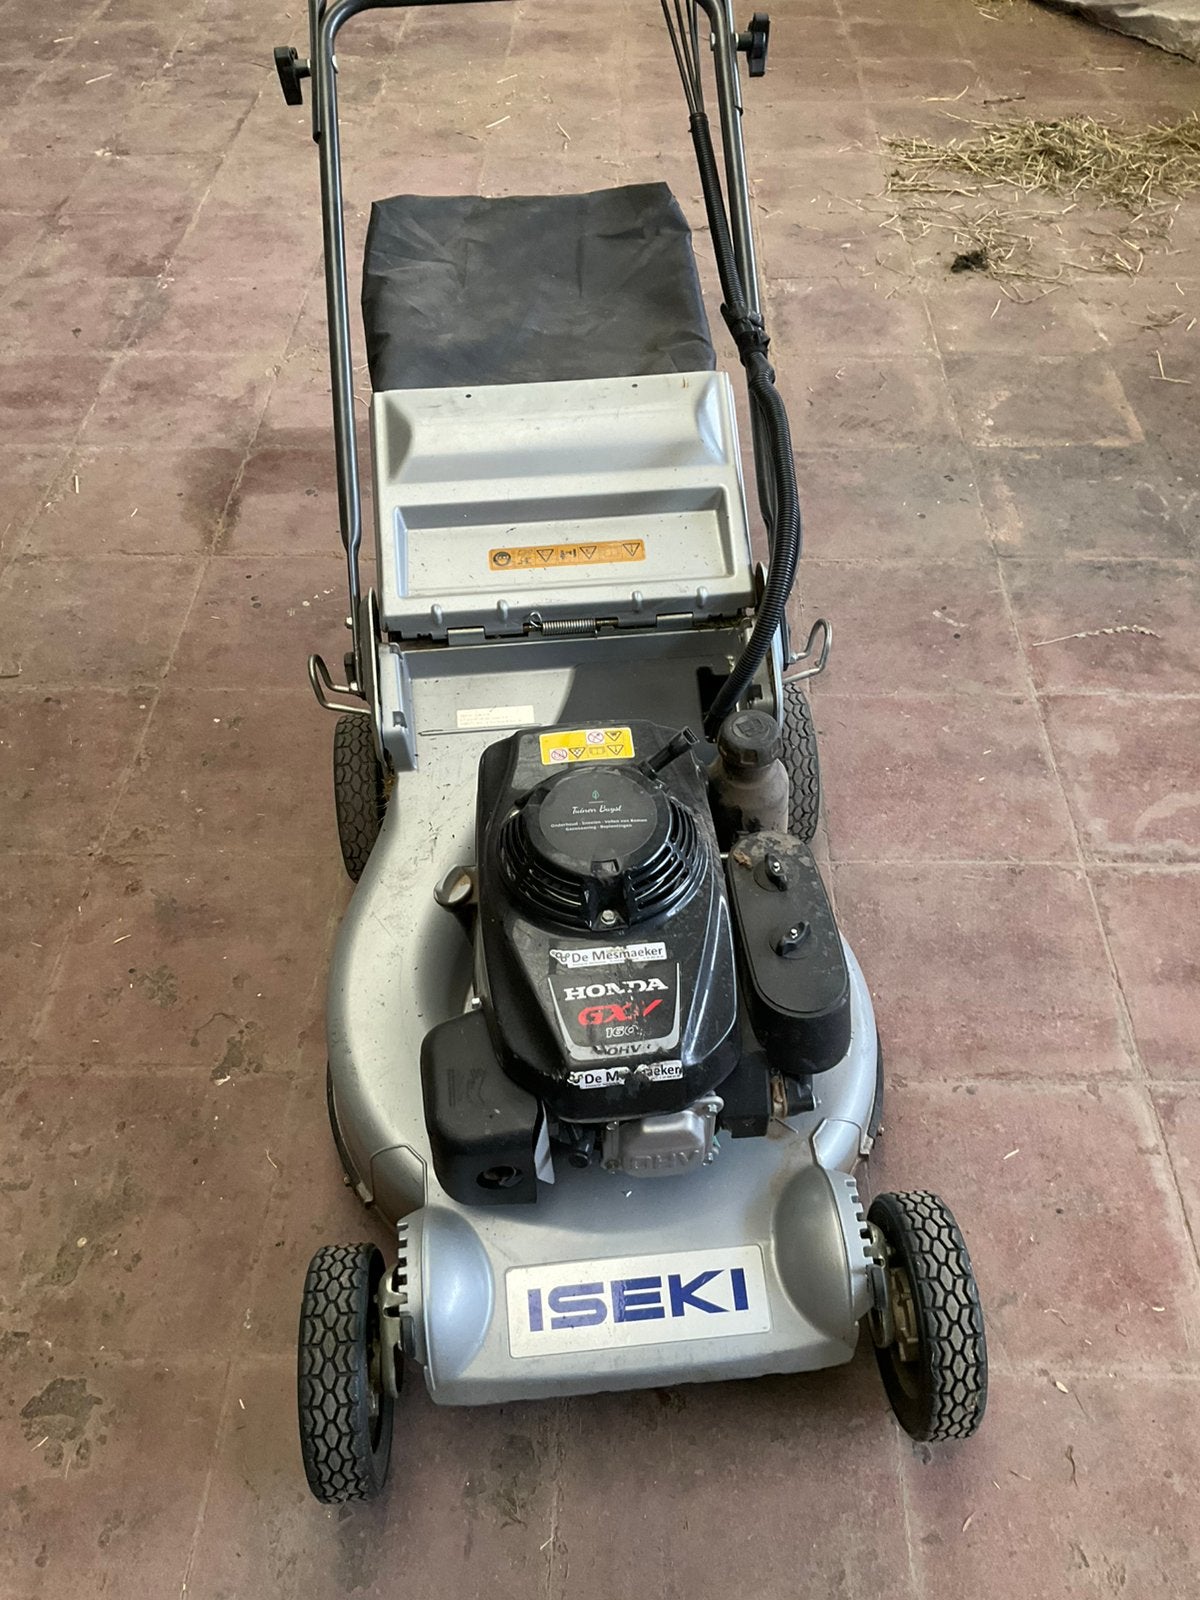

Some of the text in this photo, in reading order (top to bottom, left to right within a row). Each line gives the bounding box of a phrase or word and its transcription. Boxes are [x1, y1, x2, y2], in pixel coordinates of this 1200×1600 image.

[571, 946, 663, 963] De Mesmaeker
[564, 978, 669, 1001] HONDA
[584, 1073, 602, 1085] De
[527, 1267, 749, 1332] ISEKI
